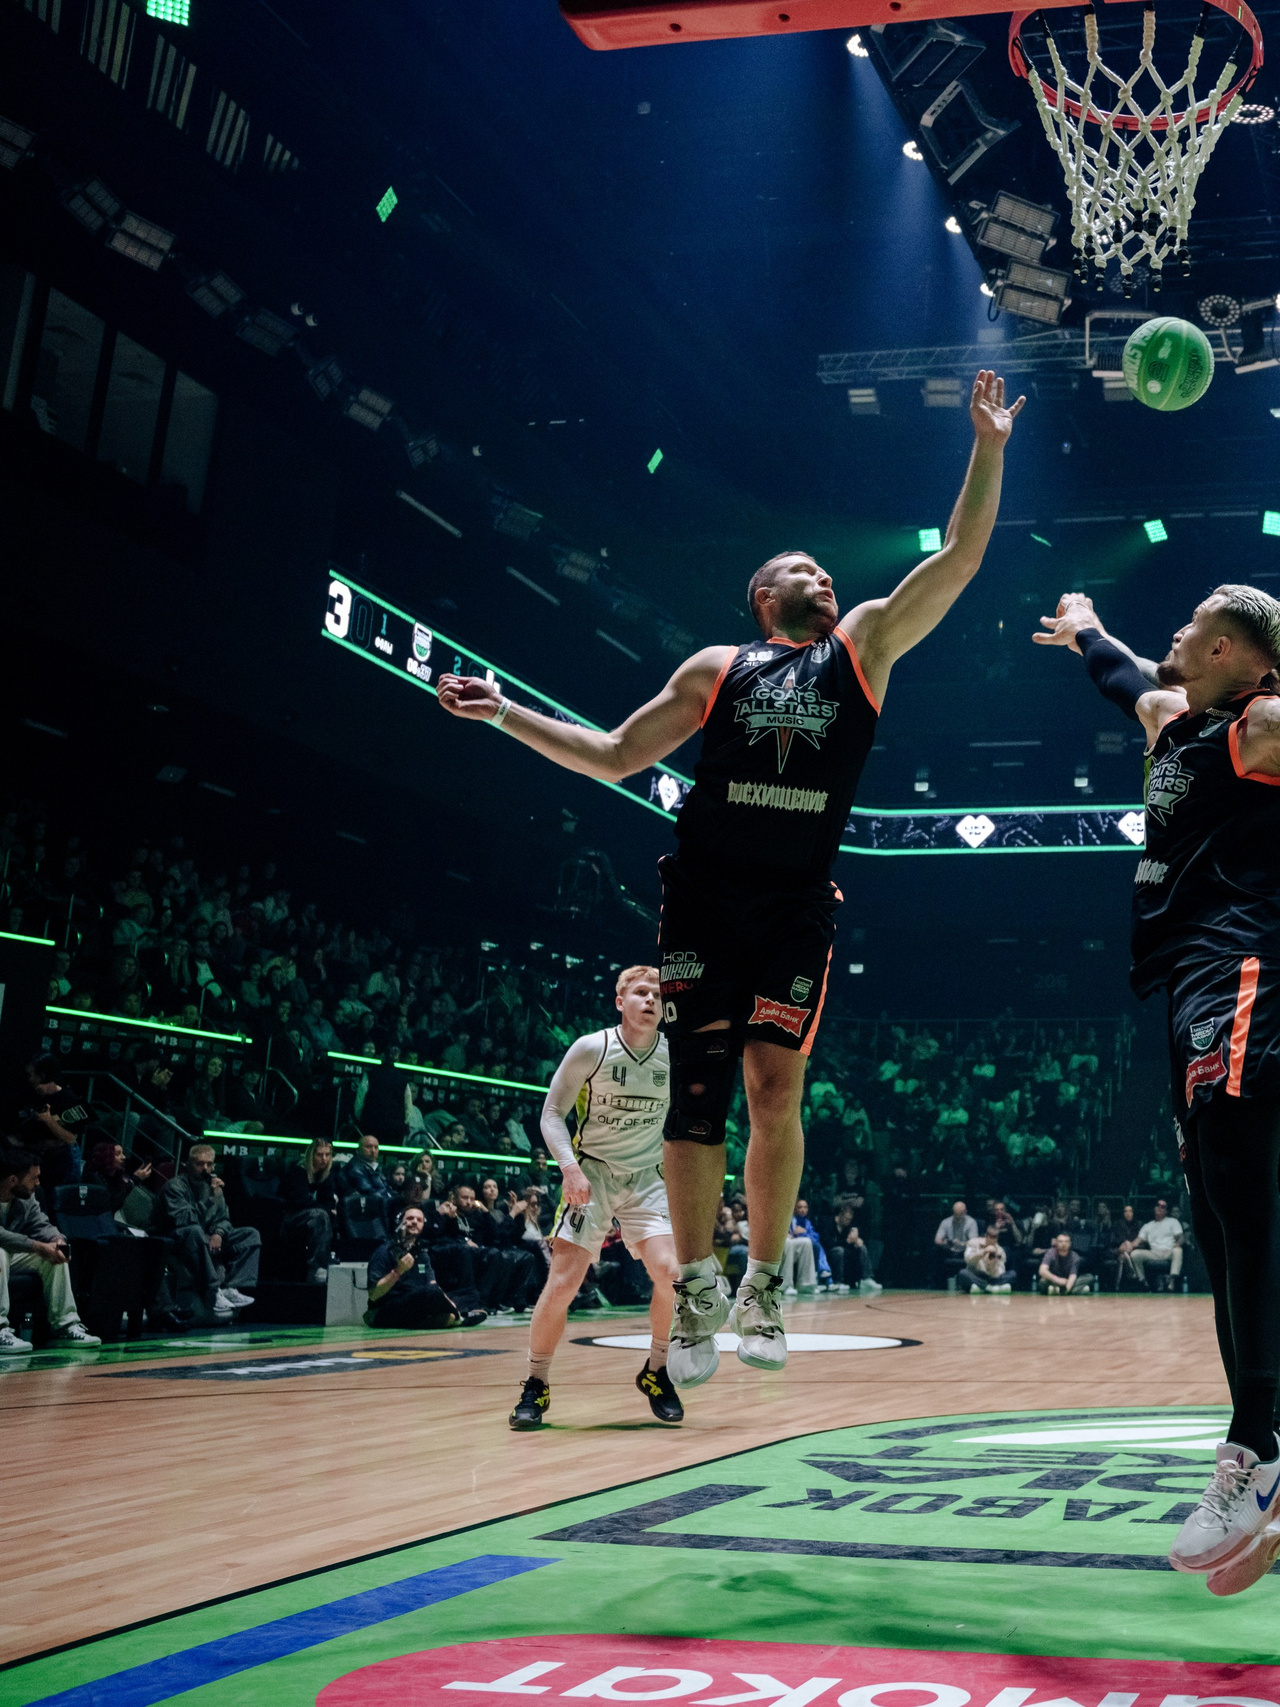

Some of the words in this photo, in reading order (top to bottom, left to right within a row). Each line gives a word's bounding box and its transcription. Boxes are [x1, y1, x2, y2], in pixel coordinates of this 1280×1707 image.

[325, 580, 352, 638] 3
[755, 688, 816, 703] GOATS
[740, 700, 833, 717] ALLSTARS
[766, 716, 804, 726] MUSIC
[662, 951, 697, 964] HQD
[611, 1065, 627, 1087] 4
[597, 1115, 621, 1126] OUT
[624, 1118, 640, 1126] OF
[569, 1212, 586, 1233] 4
[763, 1486, 1200, 1525] ТАВОК
